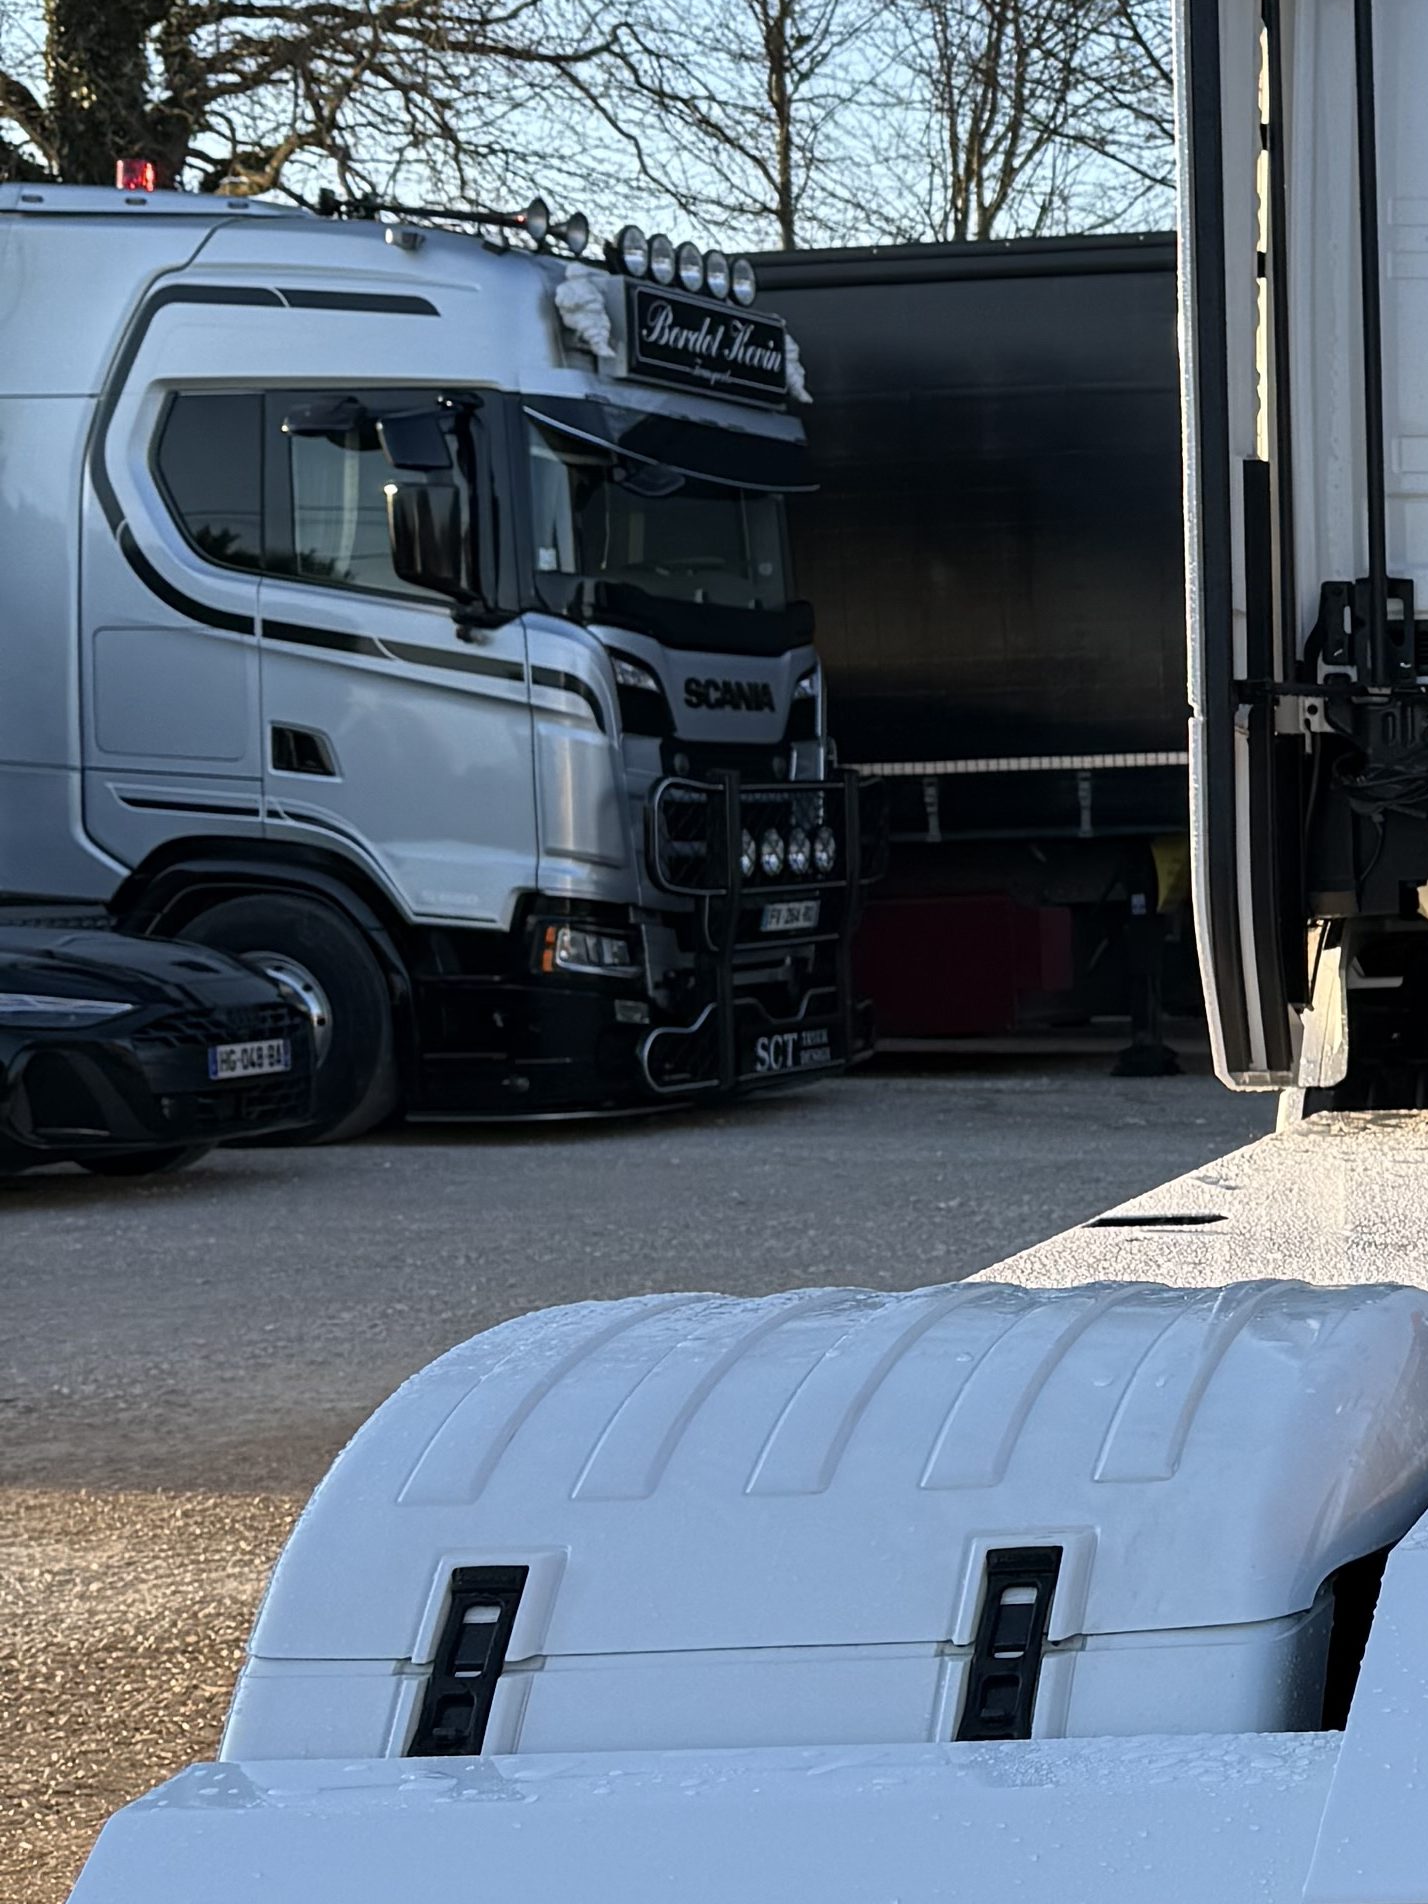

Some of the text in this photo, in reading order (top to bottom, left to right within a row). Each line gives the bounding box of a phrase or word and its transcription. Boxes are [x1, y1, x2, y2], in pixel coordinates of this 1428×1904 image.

[723, 320, 782, 373] Kevin
[684, 677, 776, 713] SCANIA
[756, 1032, 798, 1072] SCT
